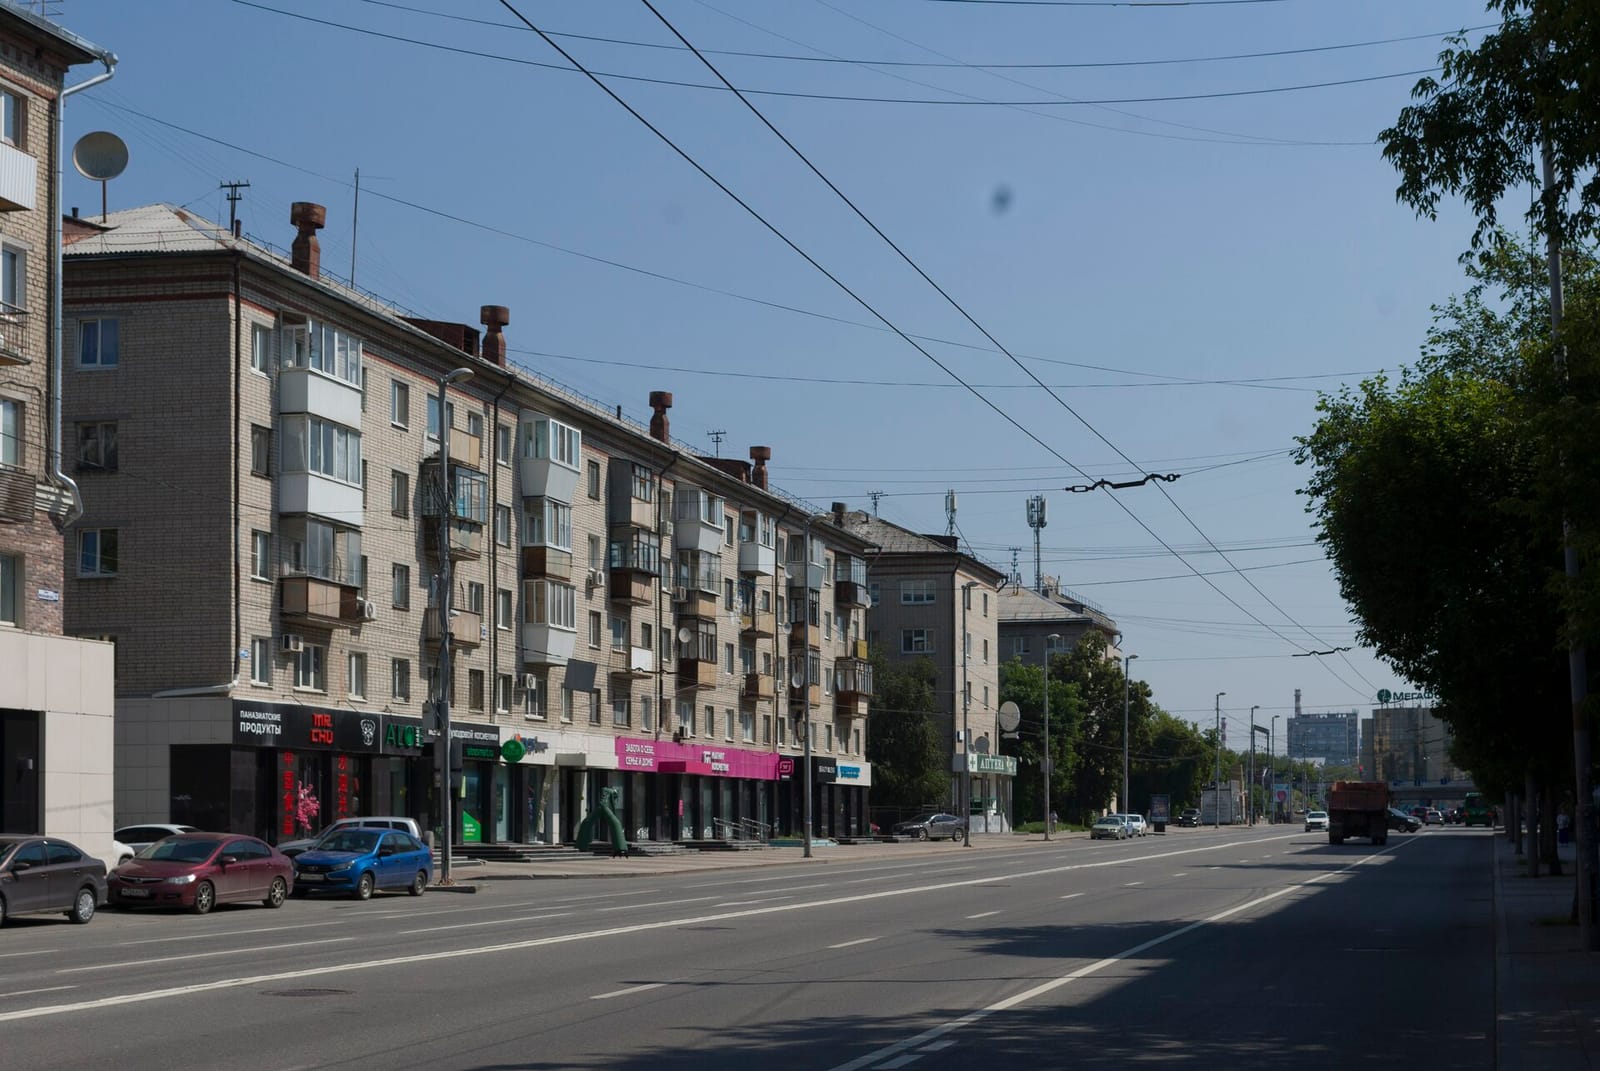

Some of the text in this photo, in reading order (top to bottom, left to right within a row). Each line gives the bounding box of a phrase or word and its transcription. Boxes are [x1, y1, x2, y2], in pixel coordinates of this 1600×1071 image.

[240, 710, 281, 721] ПАНАЗИАТСКИЕ
[240, 722, 281, 735] ПРОДУКТЫ
[311, 730, 333, 744] CHU
[980, 758, 1004, 770] АПТЕКА
